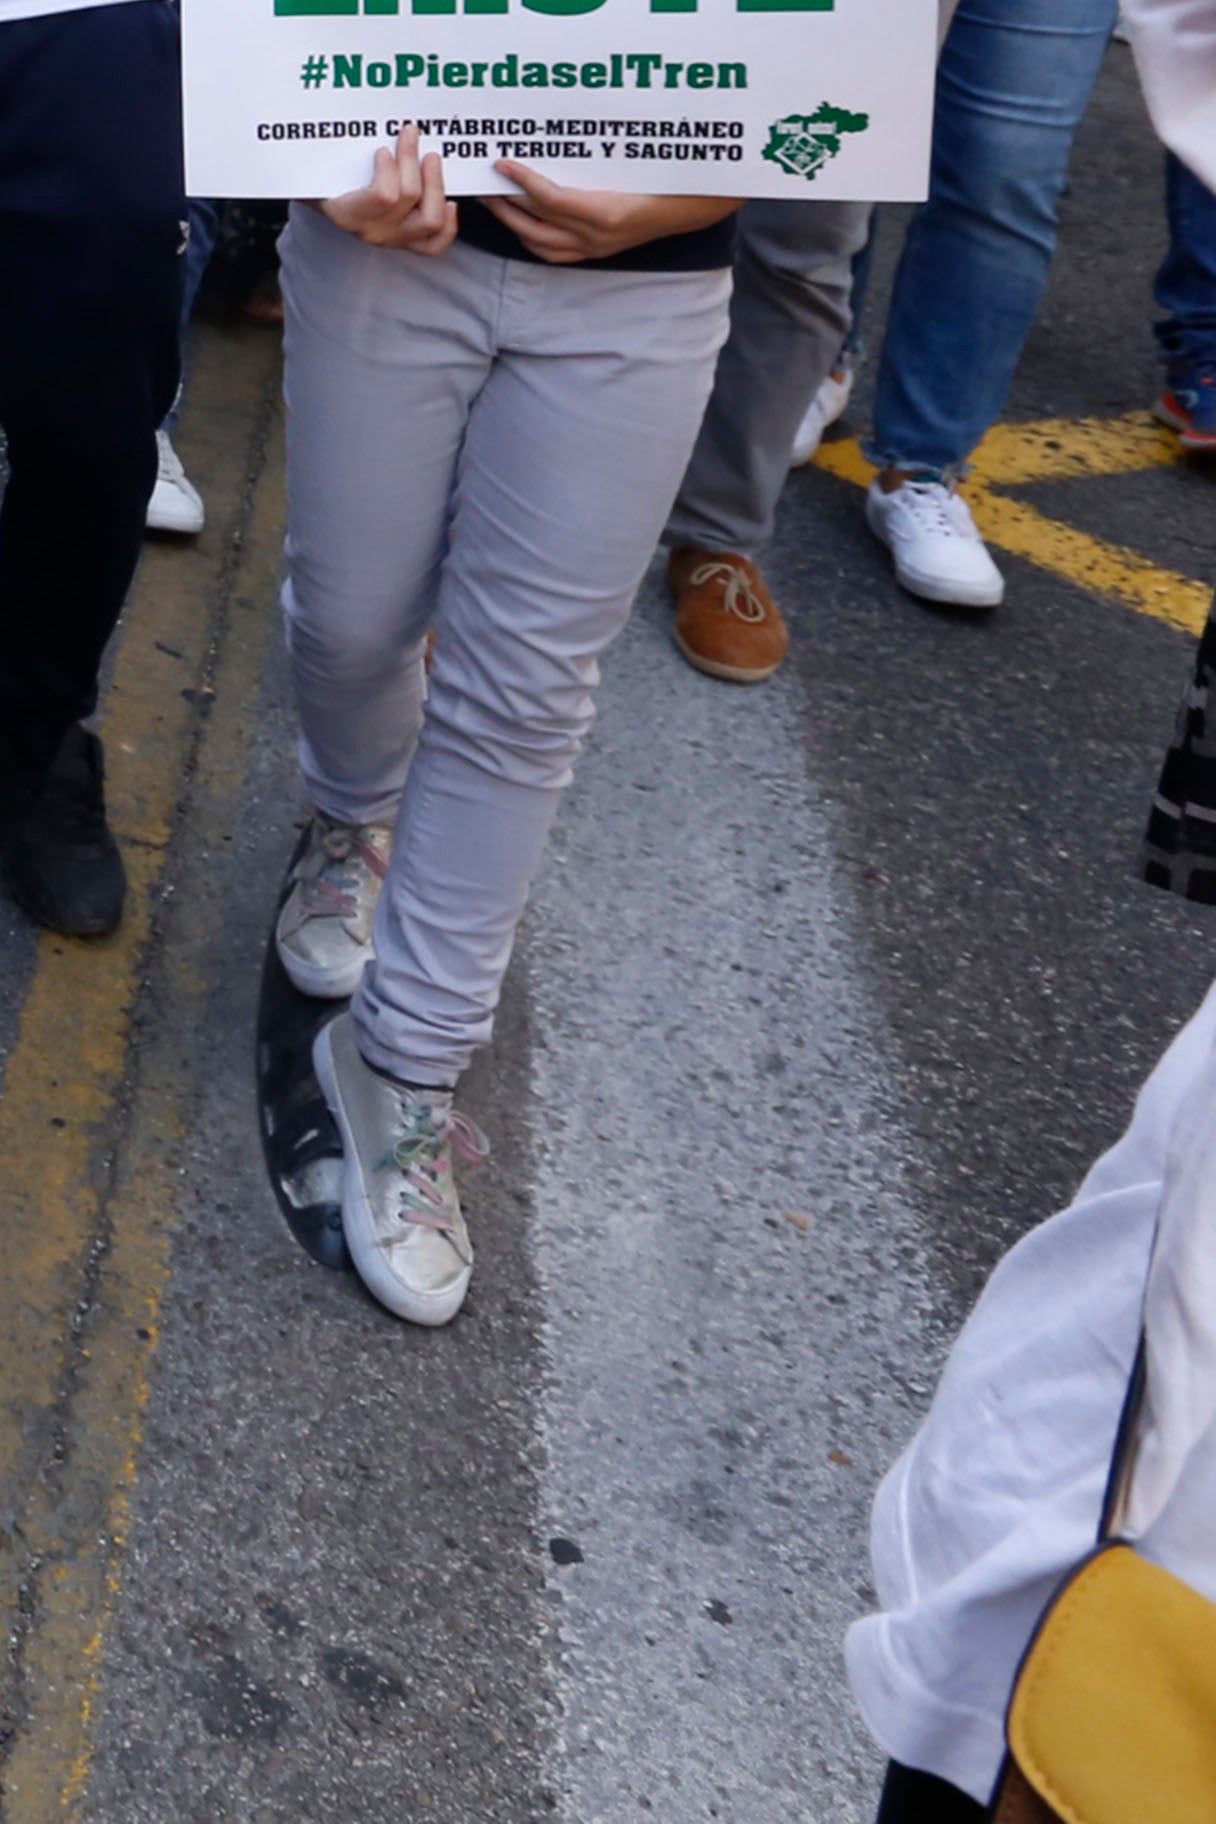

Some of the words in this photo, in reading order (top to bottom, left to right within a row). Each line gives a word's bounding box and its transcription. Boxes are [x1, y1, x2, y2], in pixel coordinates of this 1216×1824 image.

[300, 52, 749, 91] #NoPierdaselTren
[257, 119, 377, 141] CORREDOR
[441, 140, 488, 159] POR
[496, 140, 593, 160] TERUEL
[600, 140, 617, 160] Y
[624, 140, 744, 162] SAGUNTO
